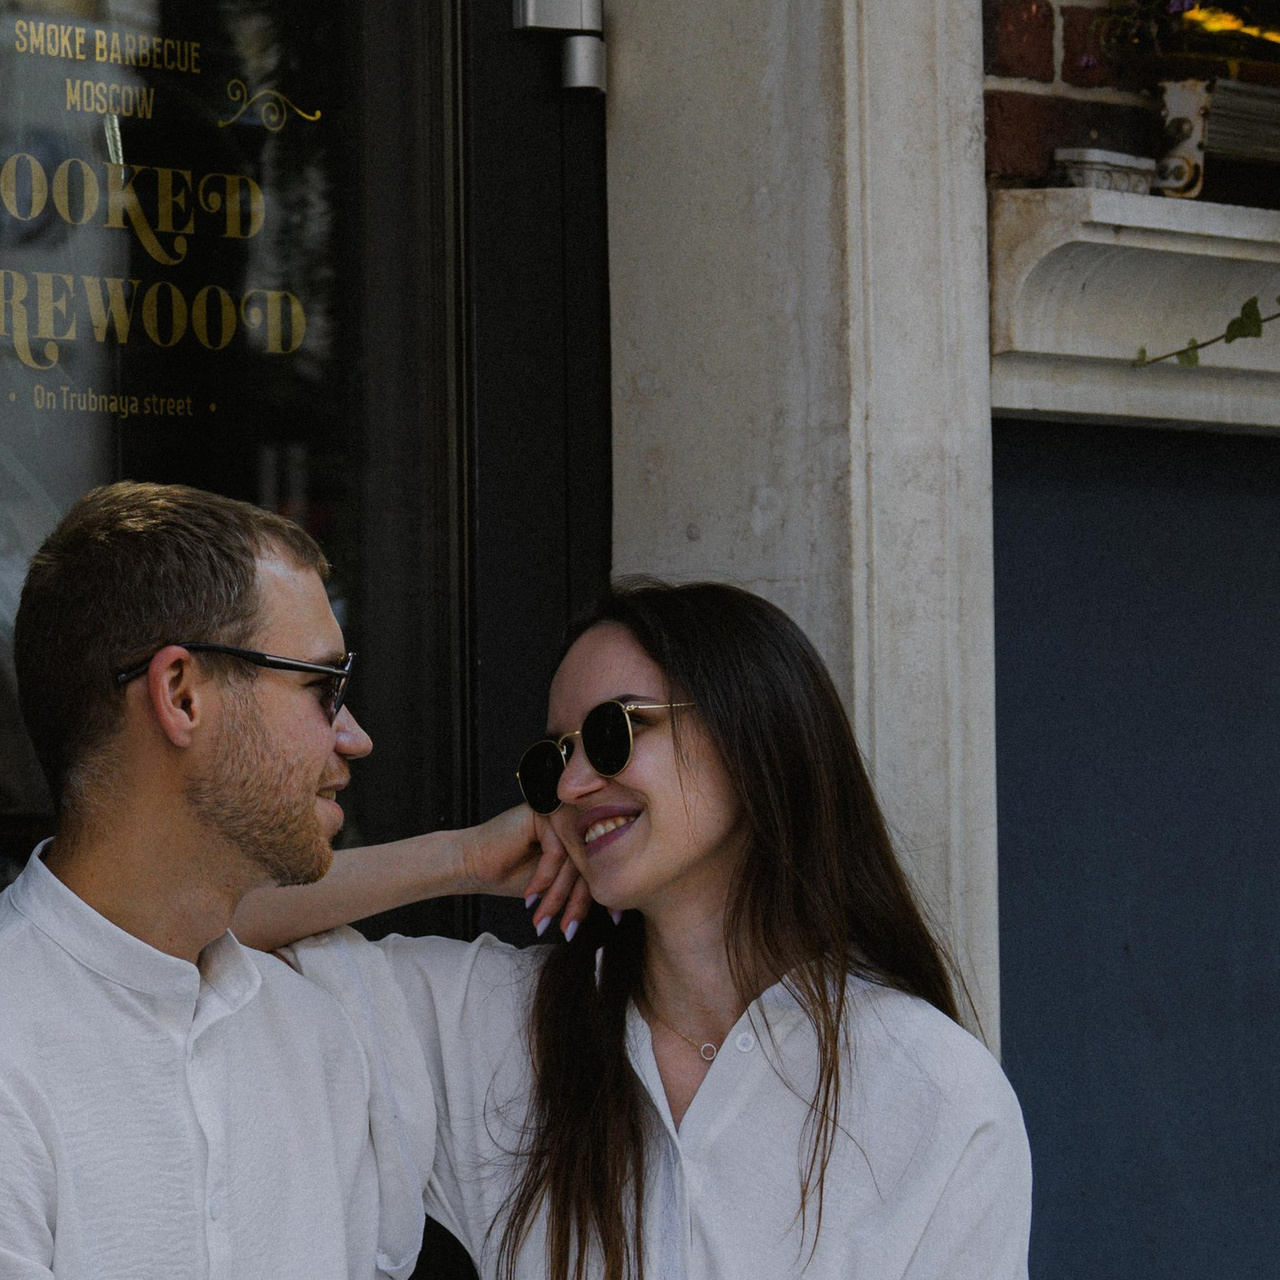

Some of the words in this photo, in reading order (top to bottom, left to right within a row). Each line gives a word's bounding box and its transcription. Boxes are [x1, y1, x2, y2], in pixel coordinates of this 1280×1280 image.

[15, 19, 86, 61] SMOKE
[94, 29, 202, 74] BARBECUE
[65, 78, 155, 120] MOSCOW
[33, 384, 56, 410] On
[60, 386, 139, 419] Trubnaya
[142, 394, 194, 417] street
